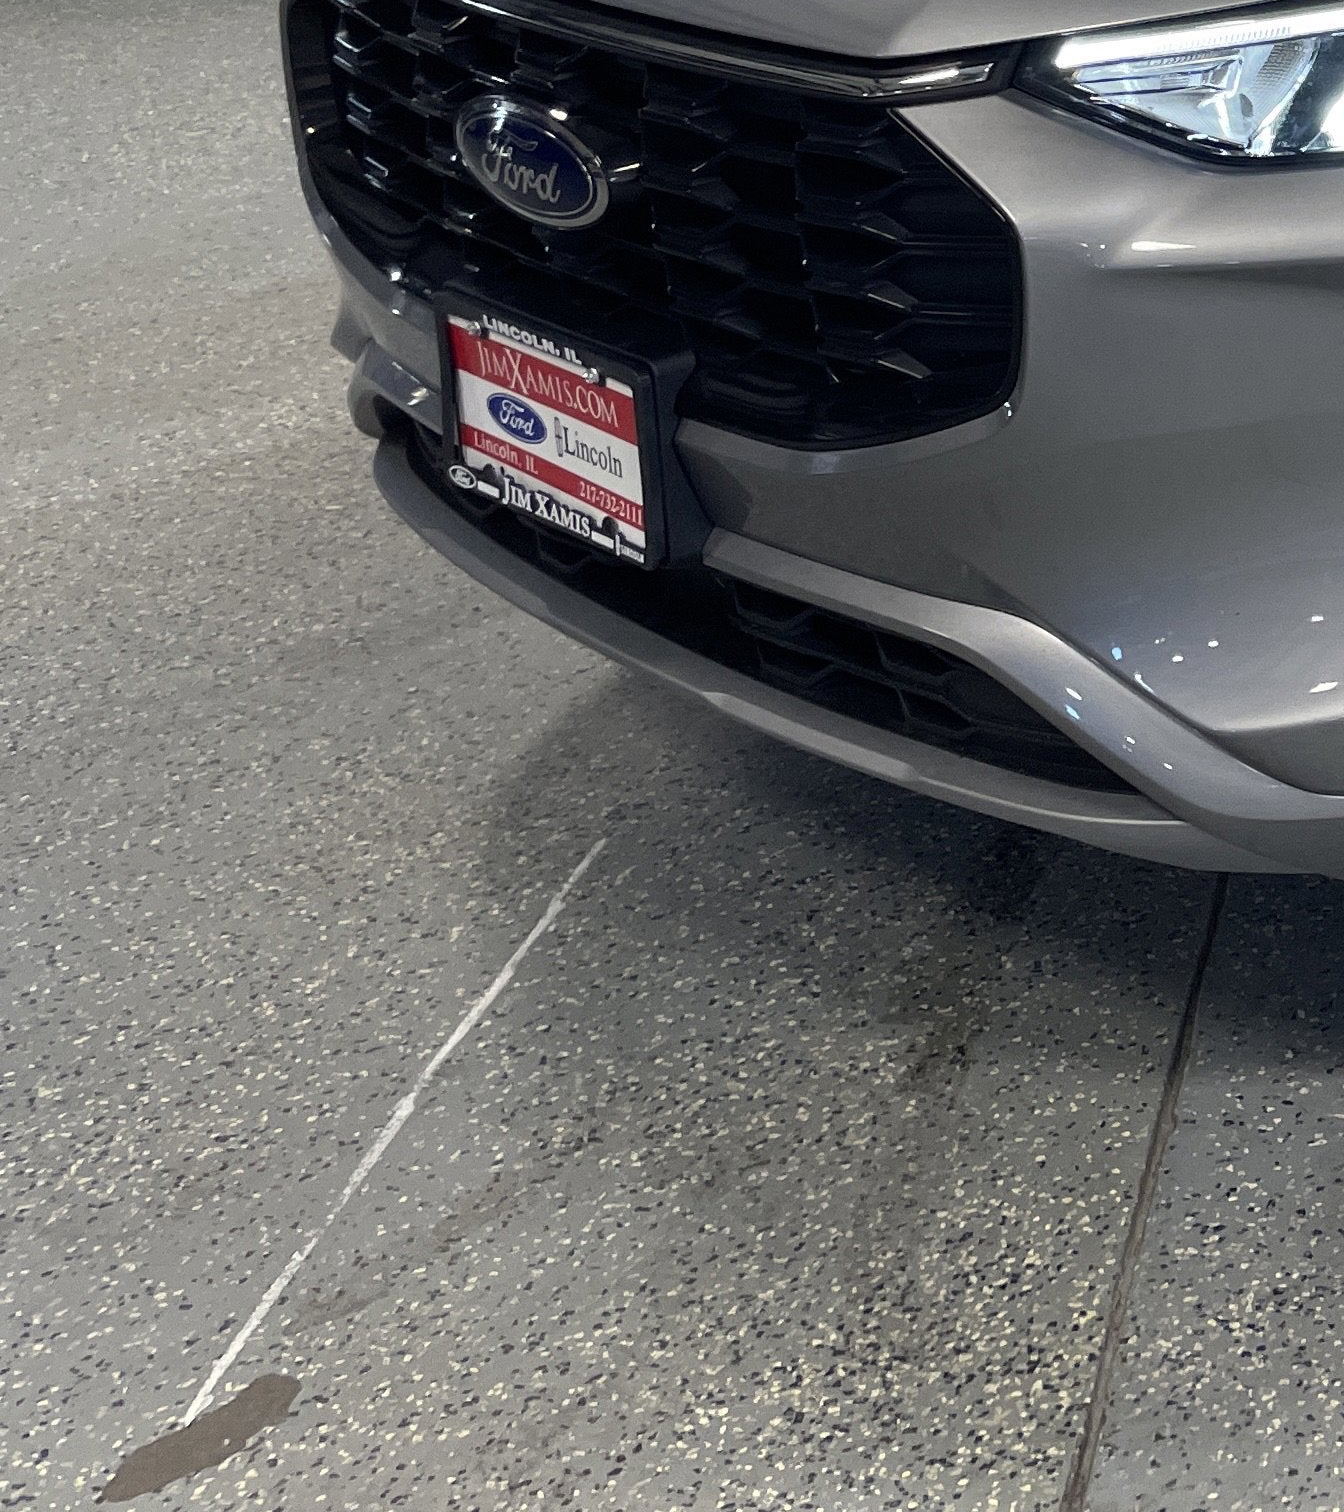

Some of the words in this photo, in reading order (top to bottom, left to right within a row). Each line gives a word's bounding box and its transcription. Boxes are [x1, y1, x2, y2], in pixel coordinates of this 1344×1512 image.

[481, 124, 561, 203] Ford
[563, 346, 583, 366] IL
[499, 399, 536, 437] Ford
[562, 425, 624, 479] Lincoln
[525, 454, 539, 476] IL
[501, 476, 533, 513] JIM
[534, 491, 591, 538] XAMIS
[580, 480, 643, 527] 217-732-2111
